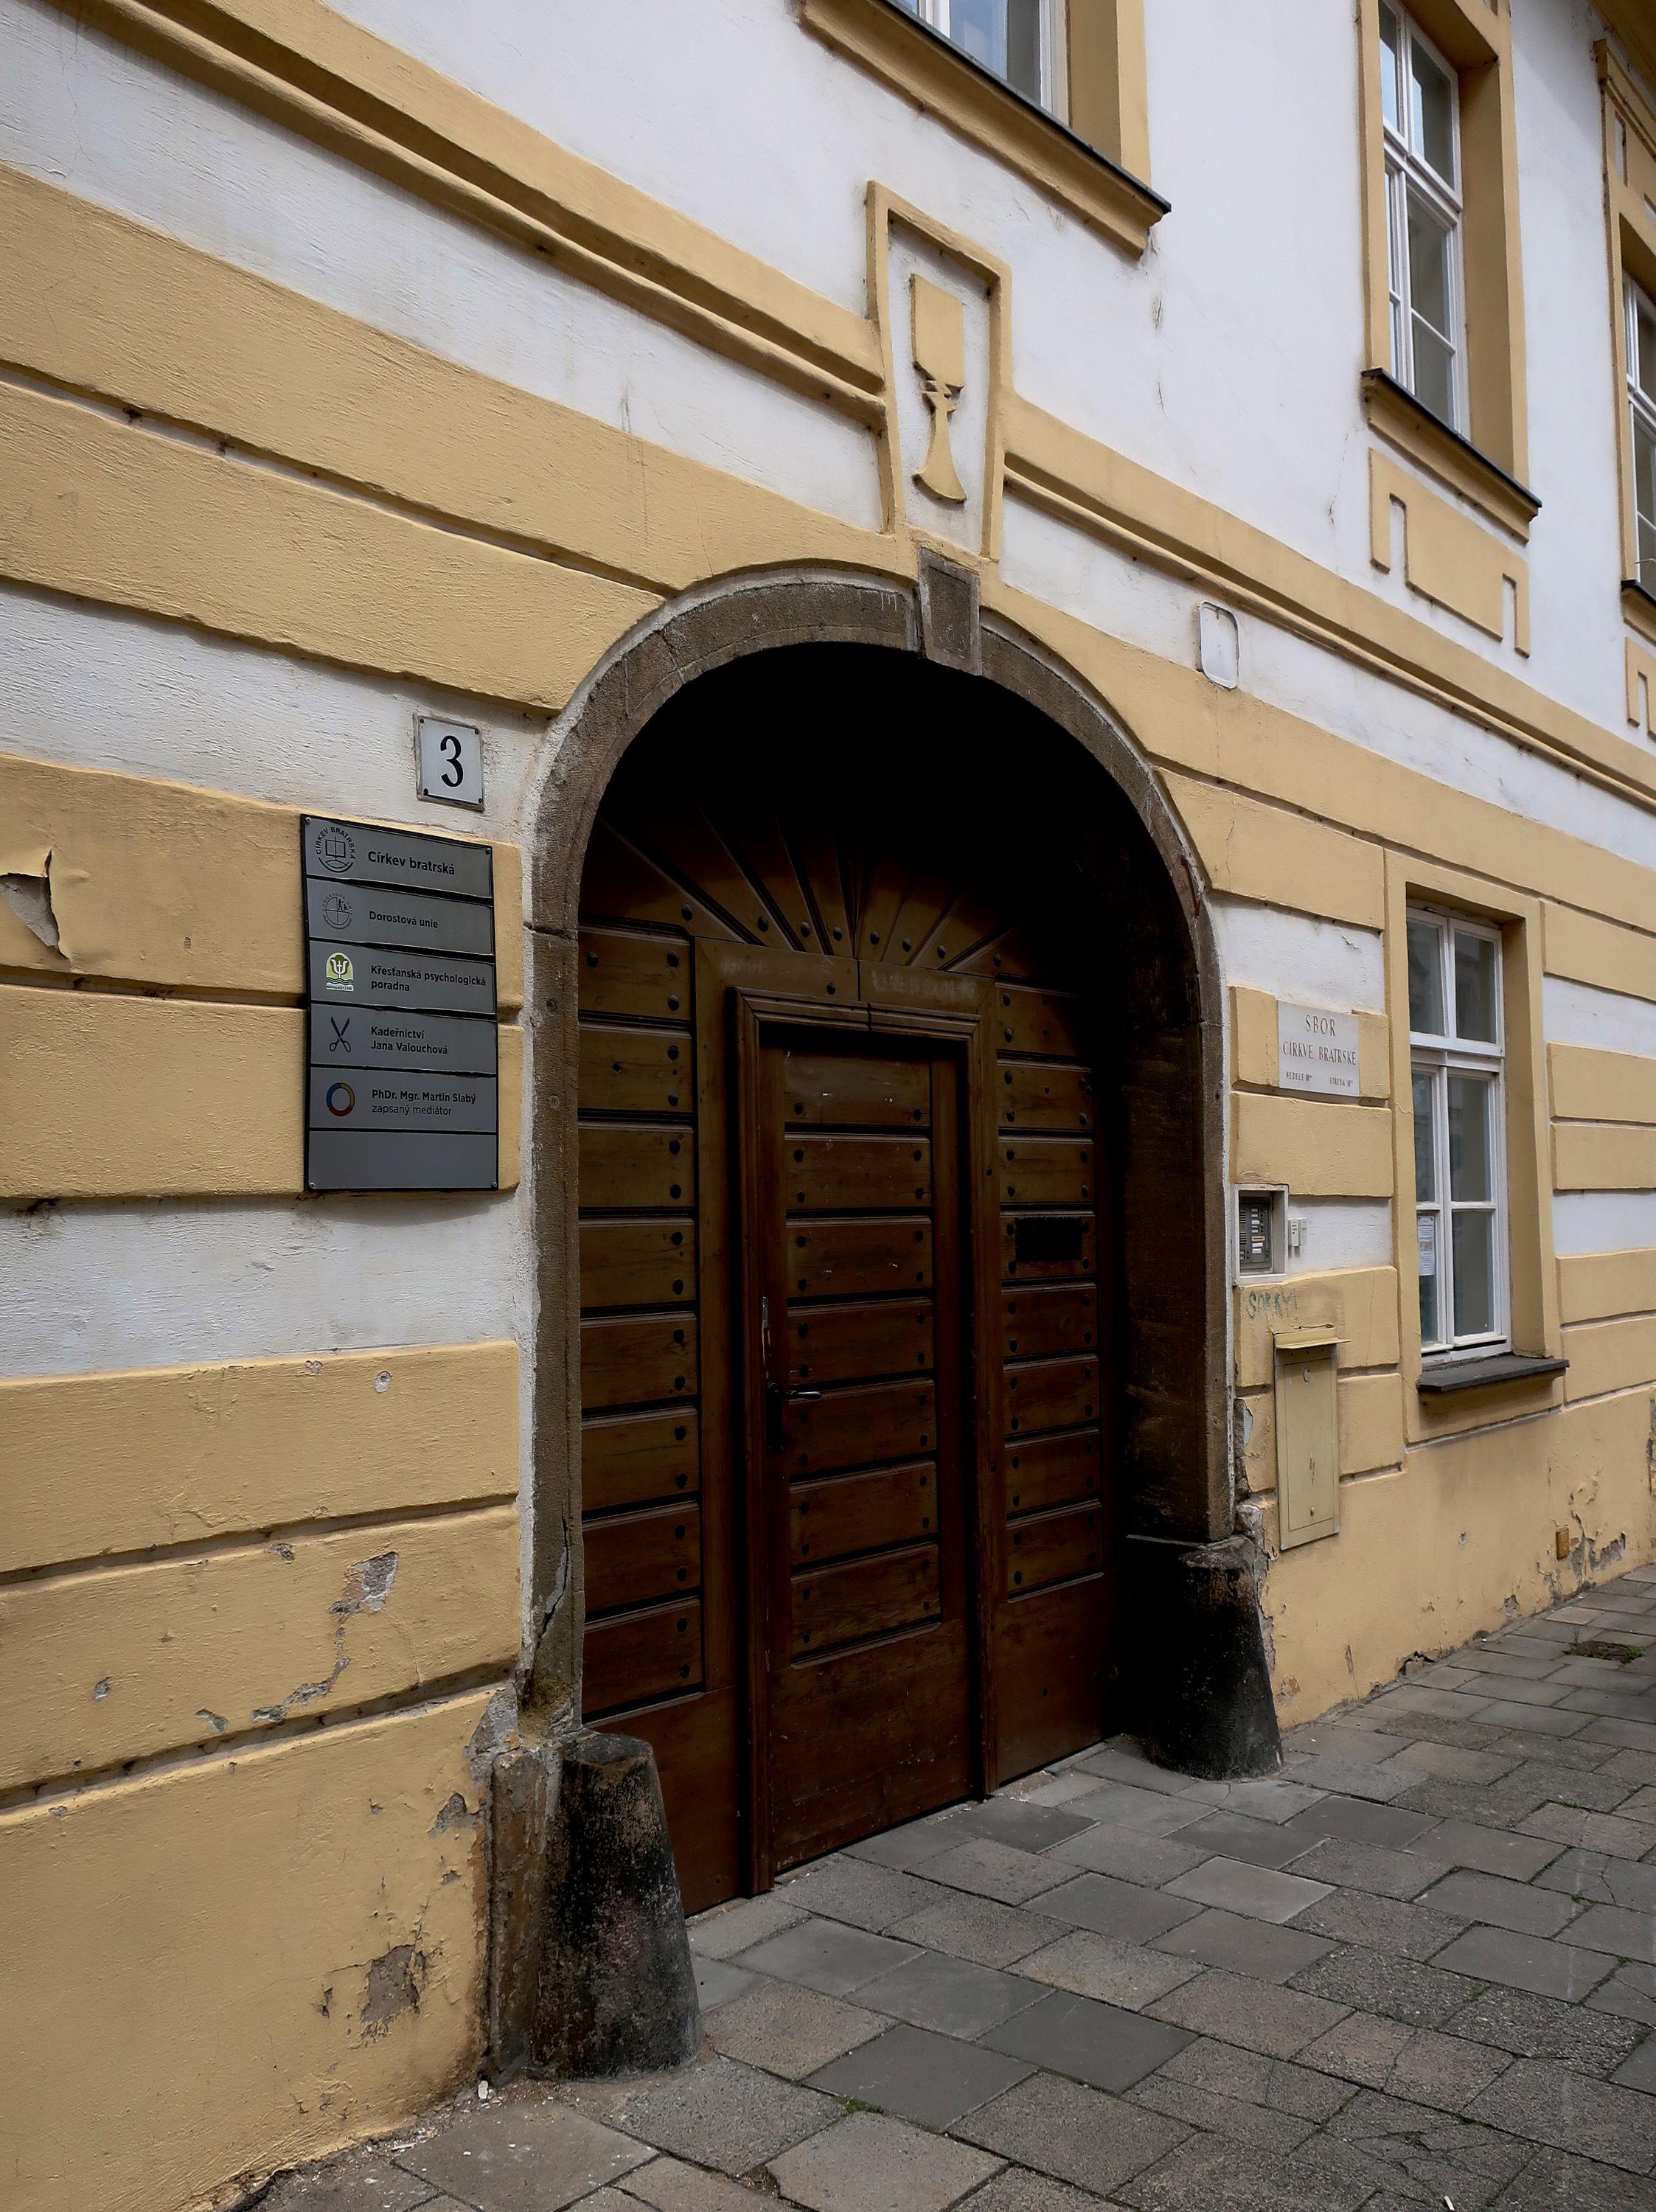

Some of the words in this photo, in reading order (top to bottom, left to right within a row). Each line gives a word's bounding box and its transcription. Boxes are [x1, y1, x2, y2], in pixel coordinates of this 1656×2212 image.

[440, 735, 464, 787] 3
[314, 827, 329, 855] CÍRKEV
[330, 826, 356, 860] BRATRSKÁ
[368, 850, 406, 866] Církev
[409, 855, 455, 875] bratrská
[369, 911, 417, 925] Dorostová
[420, 918, 438, 928] unie
[371, 965, 421, 979] Křesťanská
[424, 971, 486, 987] psychologická
[371, 979, 410, 992] poradna
[371, 1026, 425, 1040] Kadeřnictví
[1305, 1015, 1336, 1036] SBOR
[371, 1040, 393, 1051] Jana
[396, 1042, 448, 1054] Valouchová
[372, 1089, 397, 1099] PhDr.
[400, 1091, 420, 1102] Mgr.
[422, 1091, 450, 1102] Martin
[453, 1093, 476, 1105] Slabý
[372, 1105, 410, 1116] zapsaný
[412, 1105, 452, 1116] mediátor
